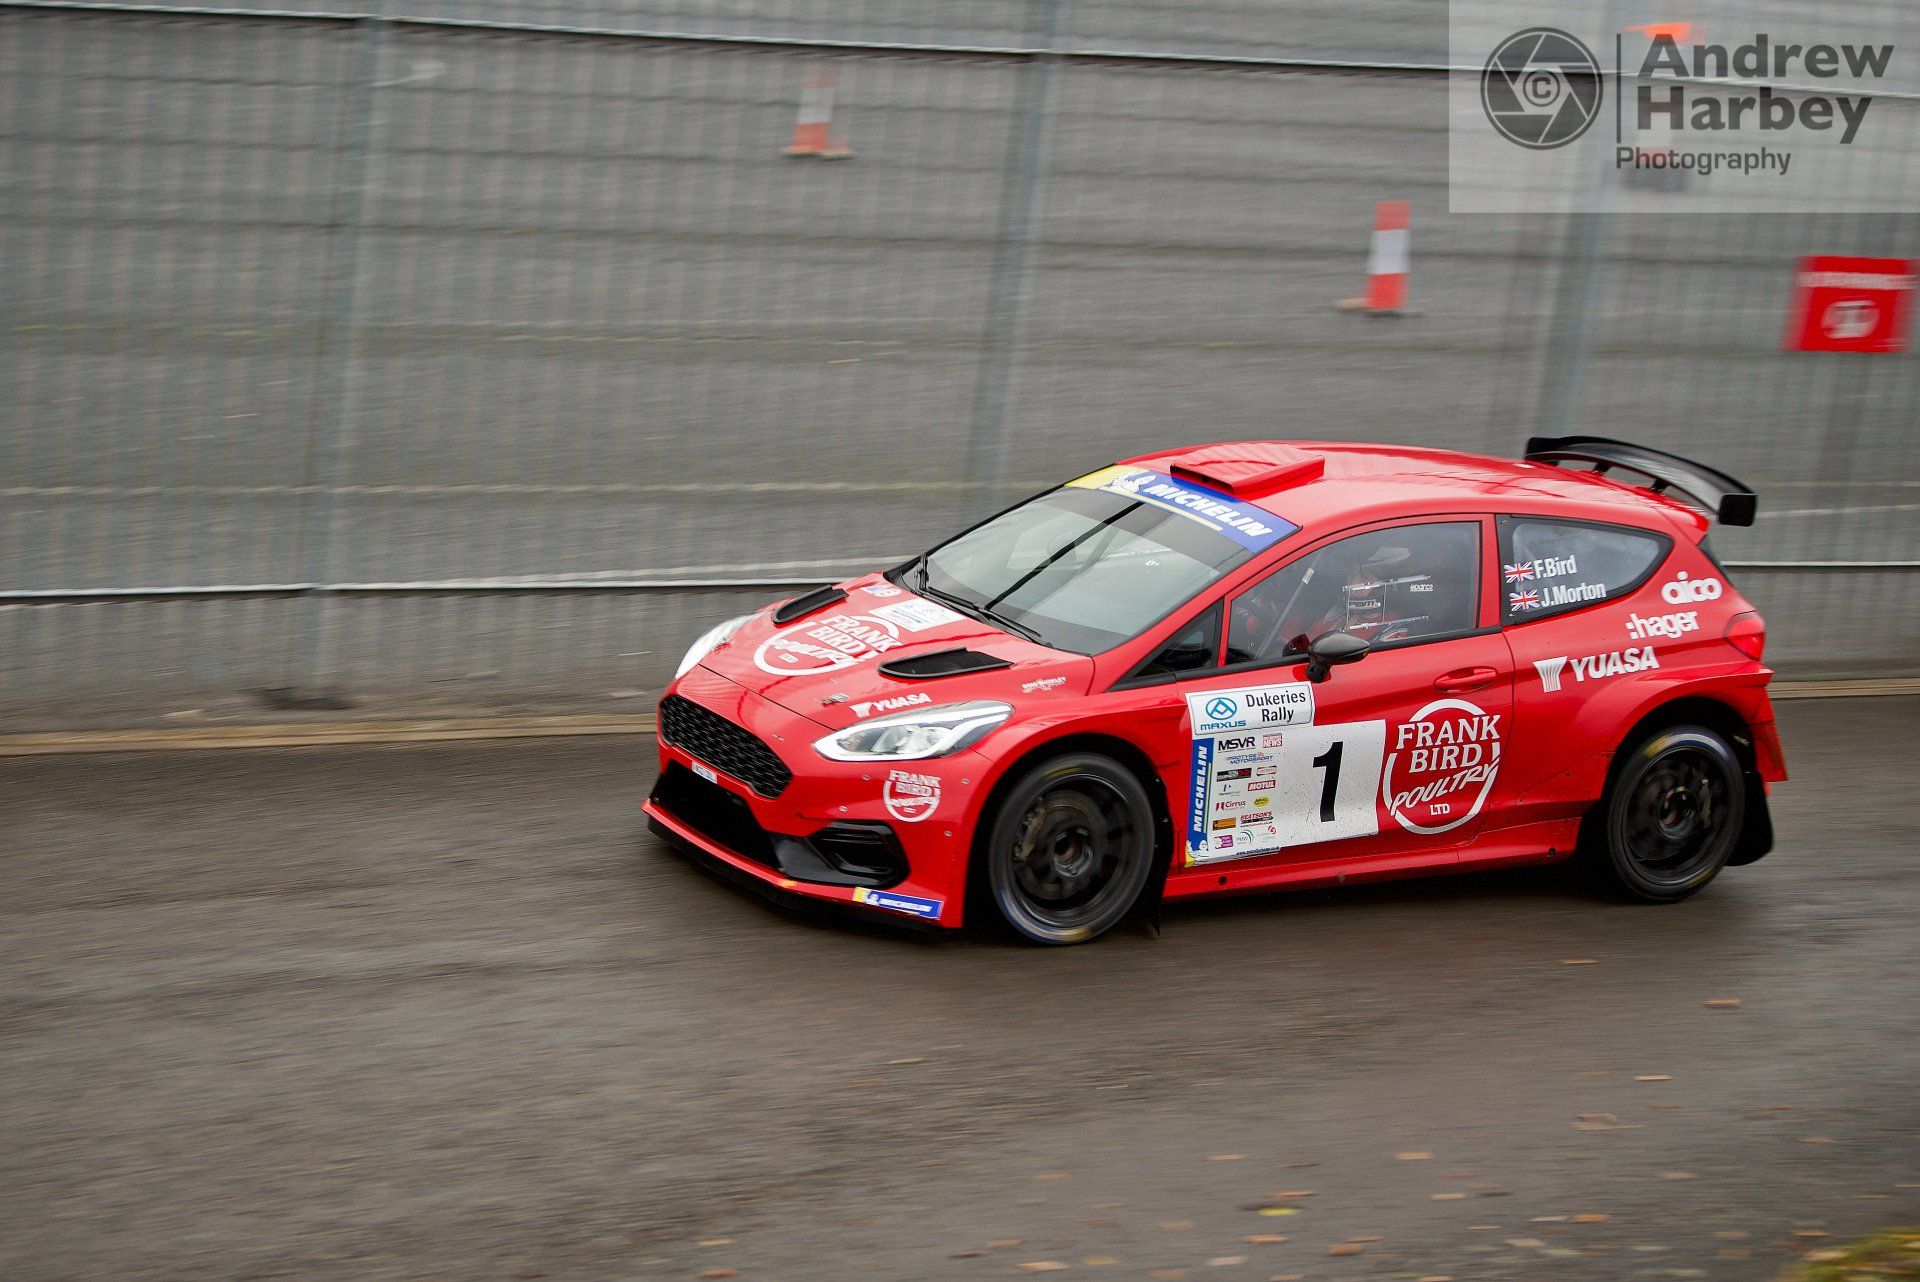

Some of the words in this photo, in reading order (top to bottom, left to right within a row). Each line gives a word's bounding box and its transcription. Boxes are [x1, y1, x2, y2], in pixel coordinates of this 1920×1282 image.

[1143, 483, 1273, 537] MICHELIN
[1533, 554, 1577, 579] F.Bird
[1540, 582, 1607, 607] J.Morton
[806, 625, 867, 654] BIRD
[820, 614, 903, 653] FRANK
[1570, 646, 1660, 682] YUASA
[872, 692, 933, 712] YUASA
[1245, 691, 1306, 708] Dukeries
[1261, 703, 1295, 722] Rally
[1263, 738, 1282, 748] NEWS
[1396, 714, 1501, 750] FRANK
[1218, 736, 1256, 751] MSVR
[1229, 755, 1274, 765] MOTORSPORT
[1409, 743, 1483, 773] BIRD
[889, 769, 943, 788] FRANK
[895, 782, 932, 797] BIRD
[1193, 746, 1208, 833] MICHELIN
[1248, 781, 1275, 791] MOTUL
[1312, 741, 1344, 823] 1
[1390, 757, 1500, 816] POULTRY
[1225, 800, 1246, 808] Cirrus
[1430, 802, 1451, 816] LTD
